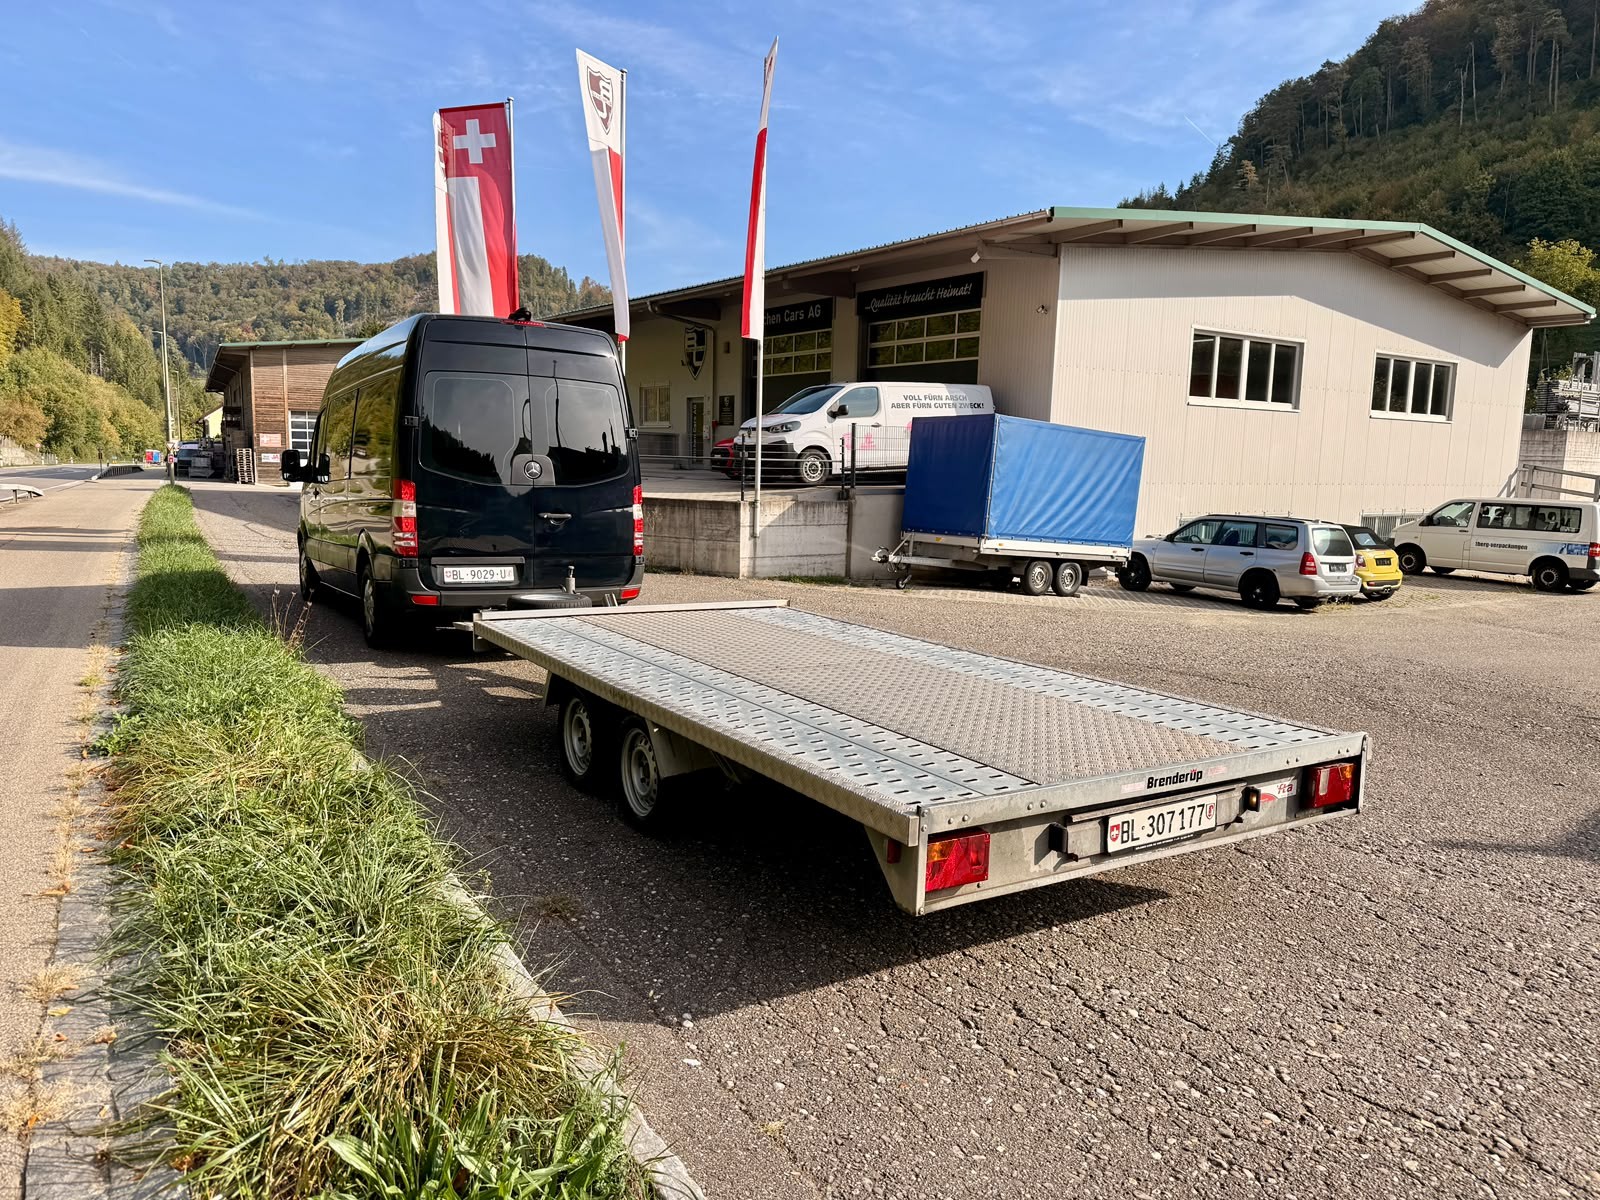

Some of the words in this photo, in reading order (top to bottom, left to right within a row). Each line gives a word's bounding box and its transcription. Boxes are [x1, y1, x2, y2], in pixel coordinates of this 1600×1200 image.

[902, 287, 936, 304] braucht
[936, 283, 973, 300] Heimat!
[784, 309, 805, 322] Cars
[808, 304, 822, 319] AG
[924, 393, 943, 401] FÜRN
[912, 401, 932, 409] FÜRN
